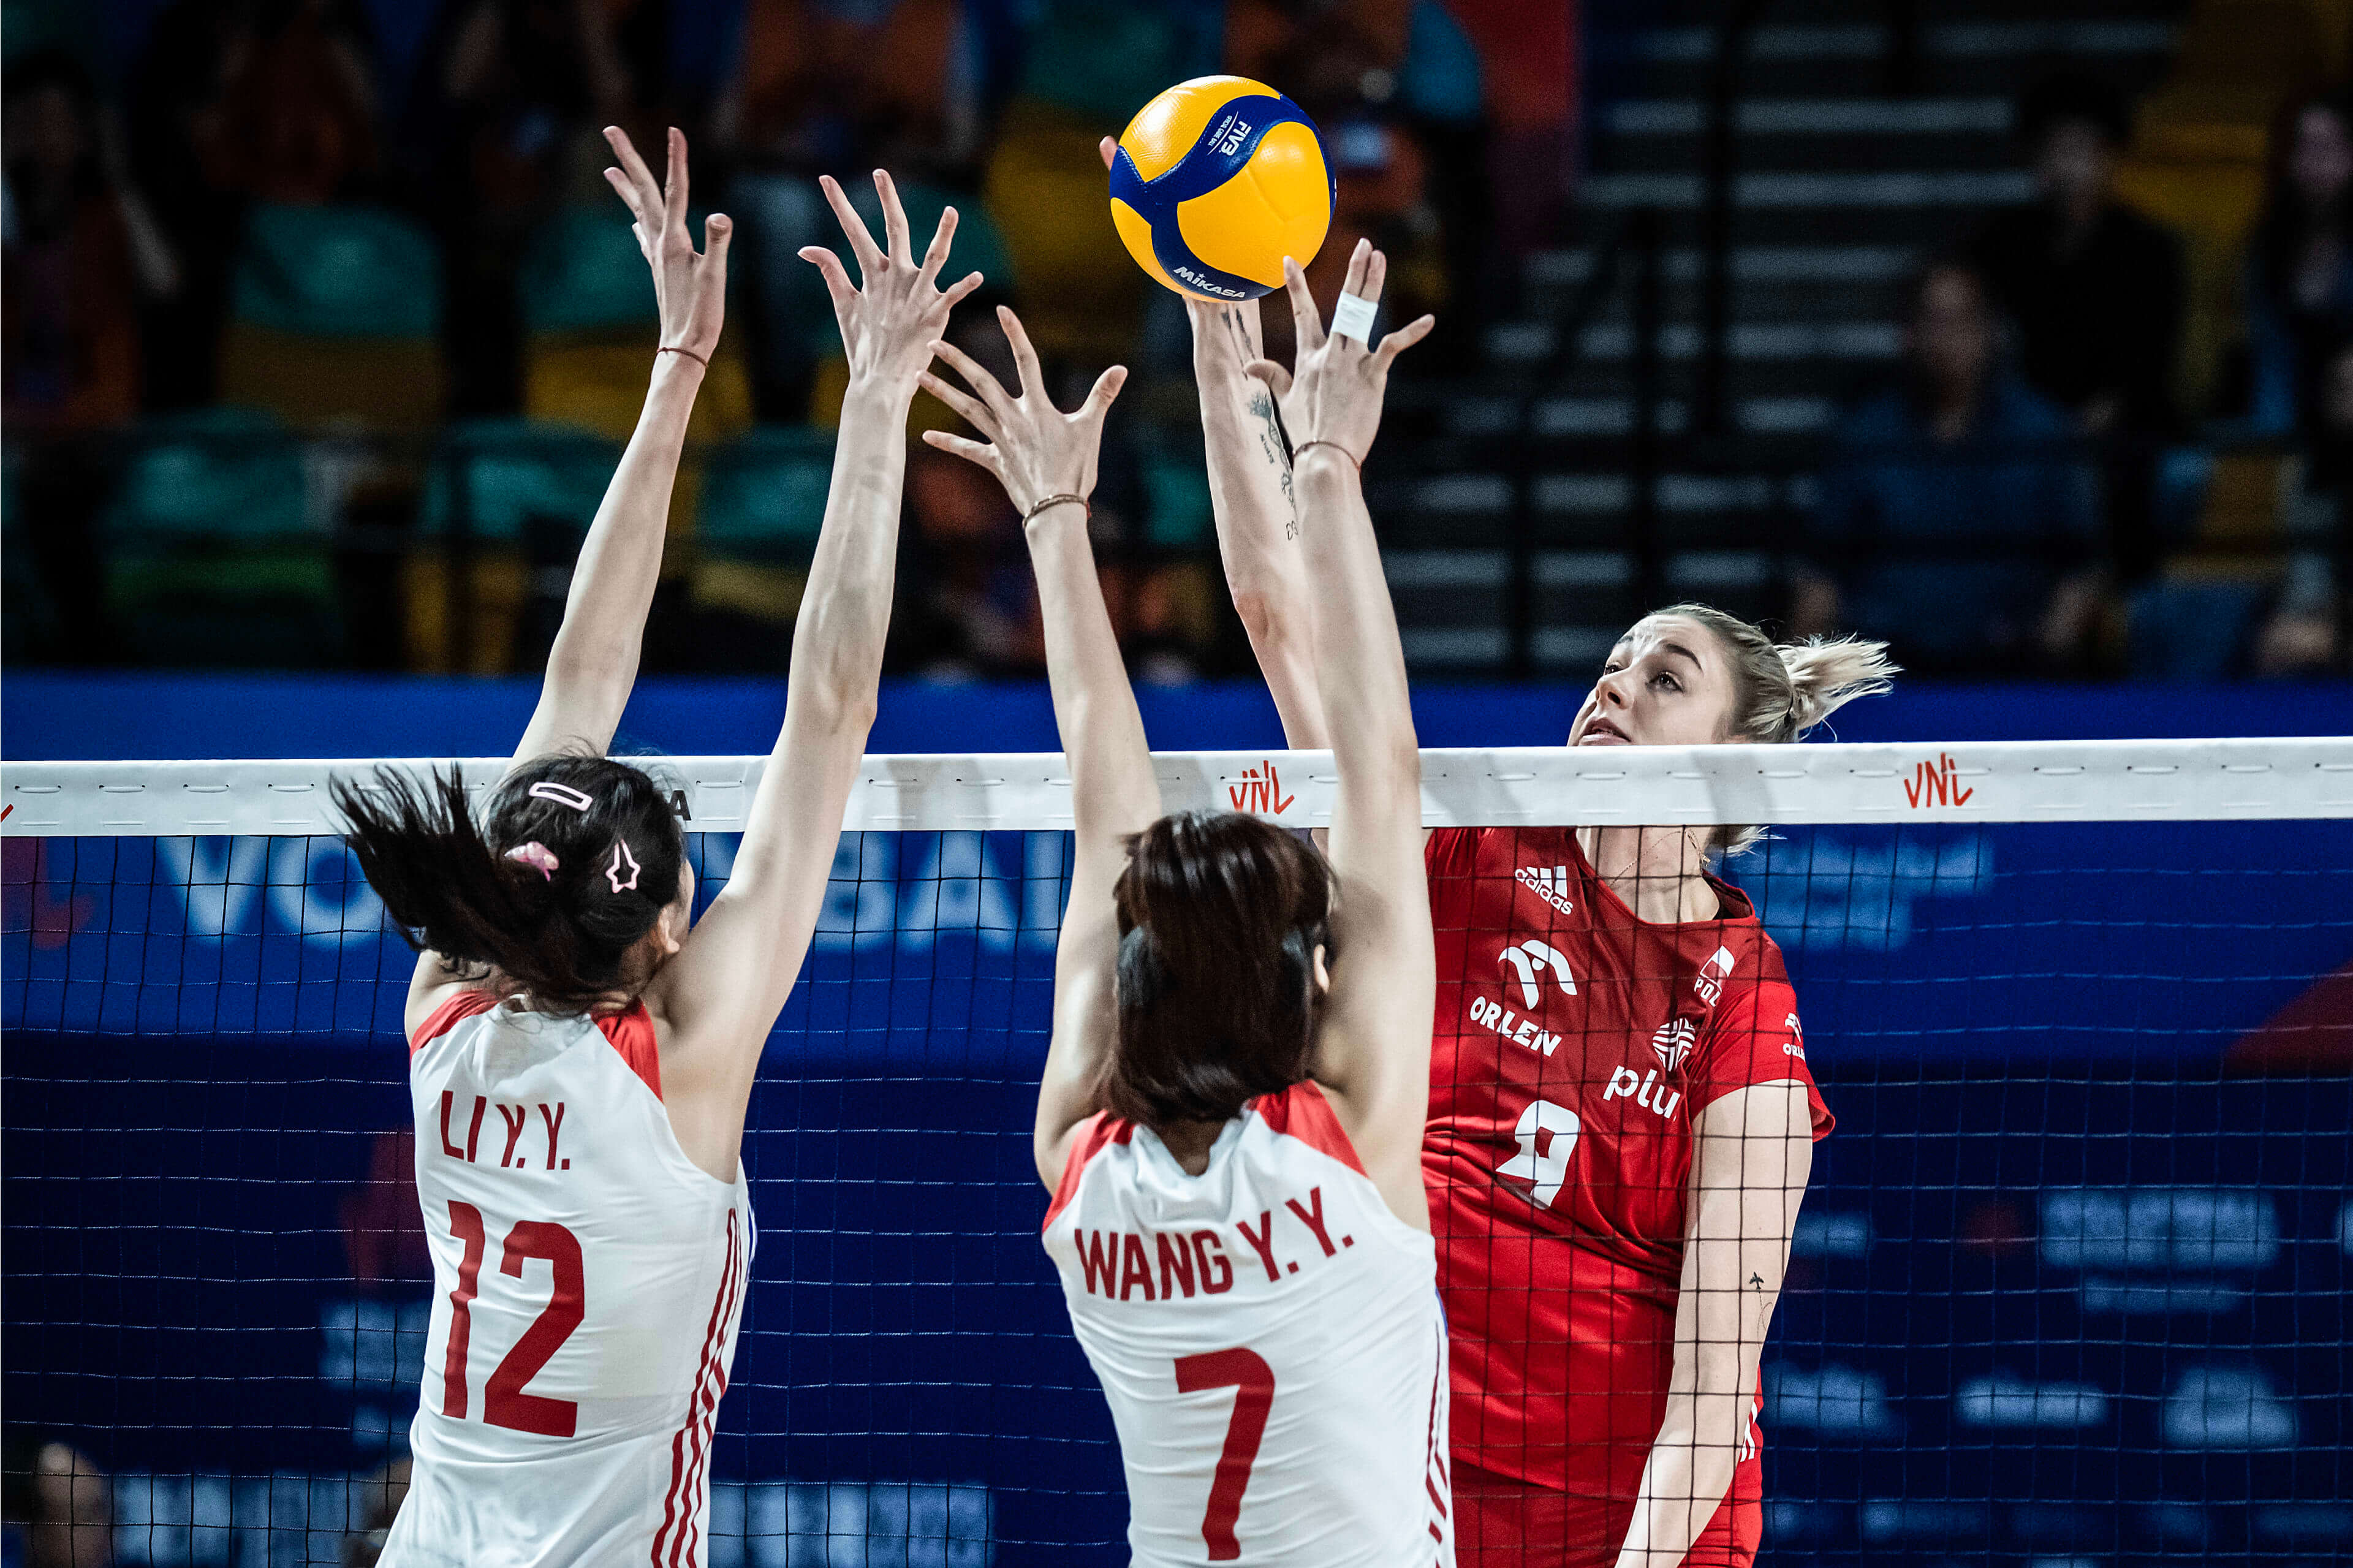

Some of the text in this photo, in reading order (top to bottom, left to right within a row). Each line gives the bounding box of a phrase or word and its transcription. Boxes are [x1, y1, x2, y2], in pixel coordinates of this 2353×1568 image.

[1221, 121, 1252, 156] FIVB
[1229, 760, 1295, 814] VNL
[1904, 752, 1973, 809] VNL
[1514, 868, 1574, 915] adidas
[1694, 976, 1721, 1007] POL
[1469, 996, 1563, 1057] ORLEN
[1602, 1065, 1681, 1122] plu
[441, 1089, 487, 1163] LI
[1496, 1100, 1581, 1210] 9
[1074, 1229, 1233, 1301] WANG
[442, 1199, 585, 1438] 12
[1173, 1347, 1276, 1561] 7
